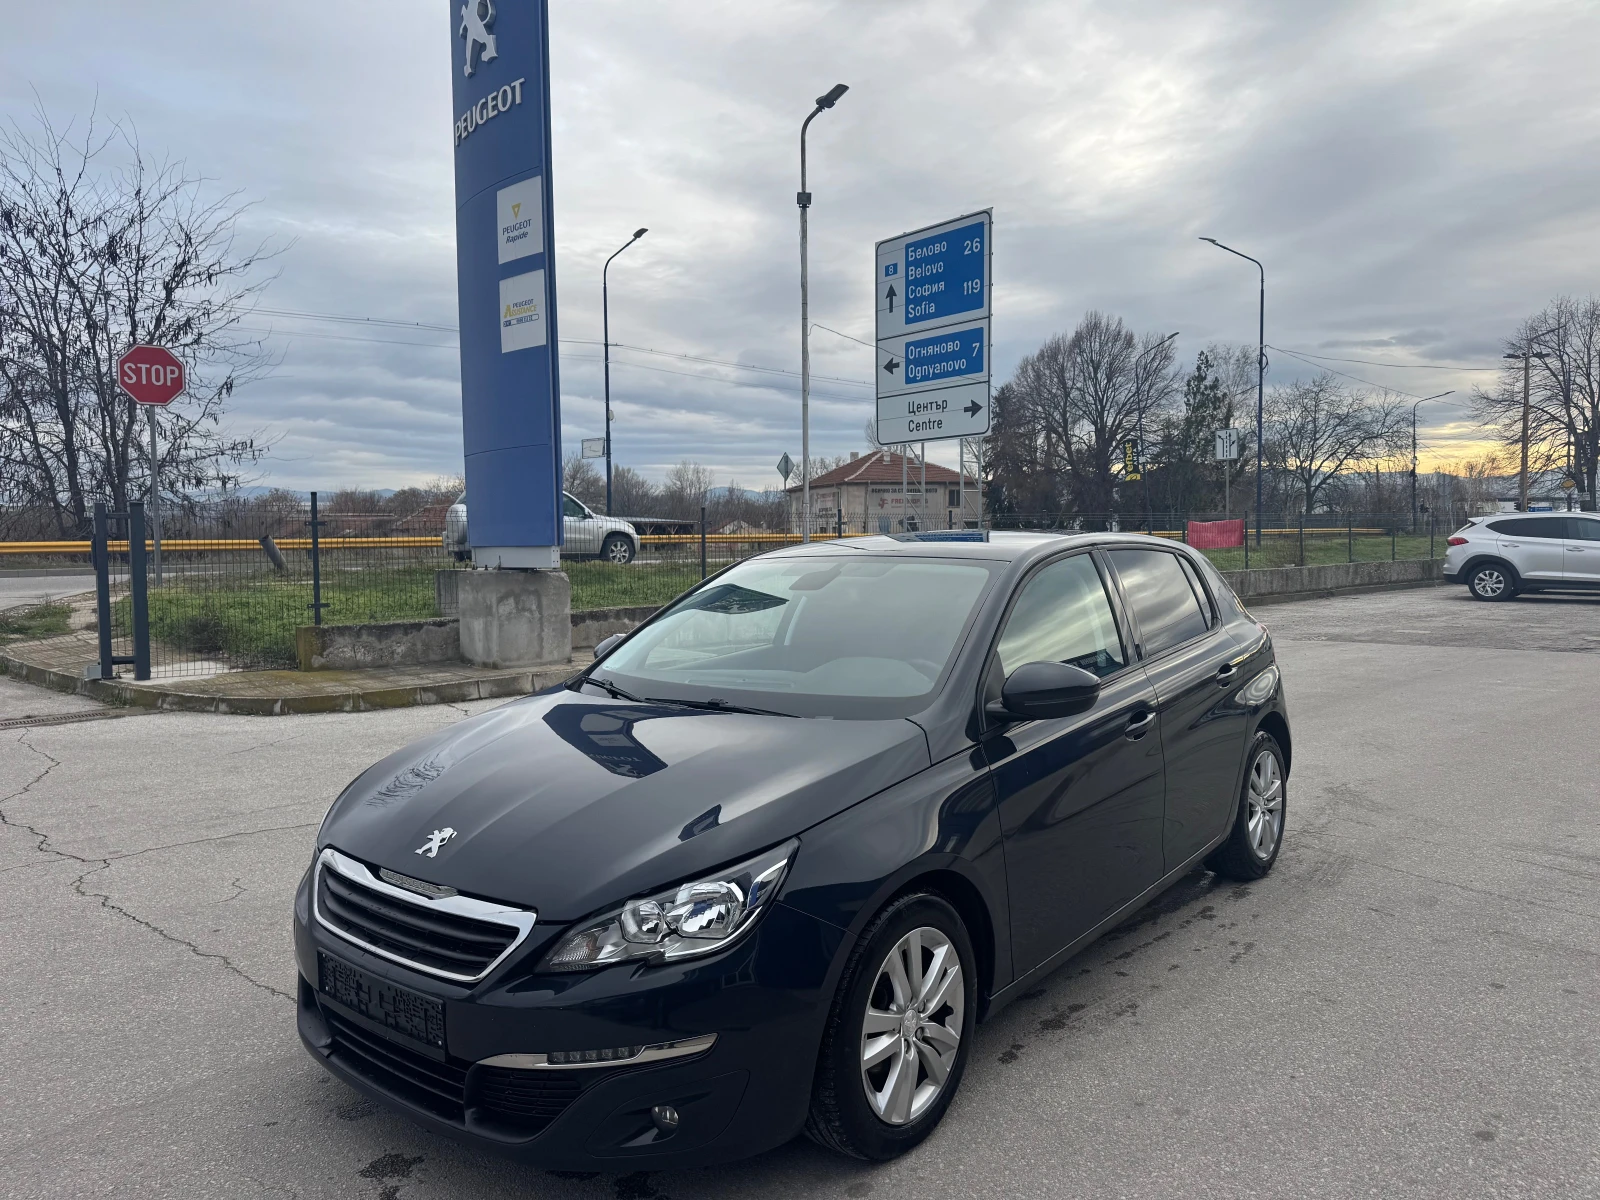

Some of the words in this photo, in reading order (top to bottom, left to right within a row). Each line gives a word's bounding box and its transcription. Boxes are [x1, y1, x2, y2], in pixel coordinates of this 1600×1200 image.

[455, 78, 525, 146] PEUGEOT
[502, 218, 532, 236] PEUGEOT
[506, 231, 528, 244] Rapide
[908, 241, 947, 260] Белово
[964, 238, 980, 255] 26
[888, 265, 894, 274] 8
[908, 261, 944, 280] Belovo
[908, 281, 945, 298] София
[963, 279, 980, 295] 119
[908, 301, 935, 318] Sofia
[908, 340, 960, 359] Огняново
[972, 343, 980, 357] 7
[124, 362, 179, 386] STOP
[908, 358, 967, 380] Ognyanovo
[908, 399, 948, 416] Център
[908, 418, 943, 432] Centre
[1125, 442, 1133, 472] efbet
